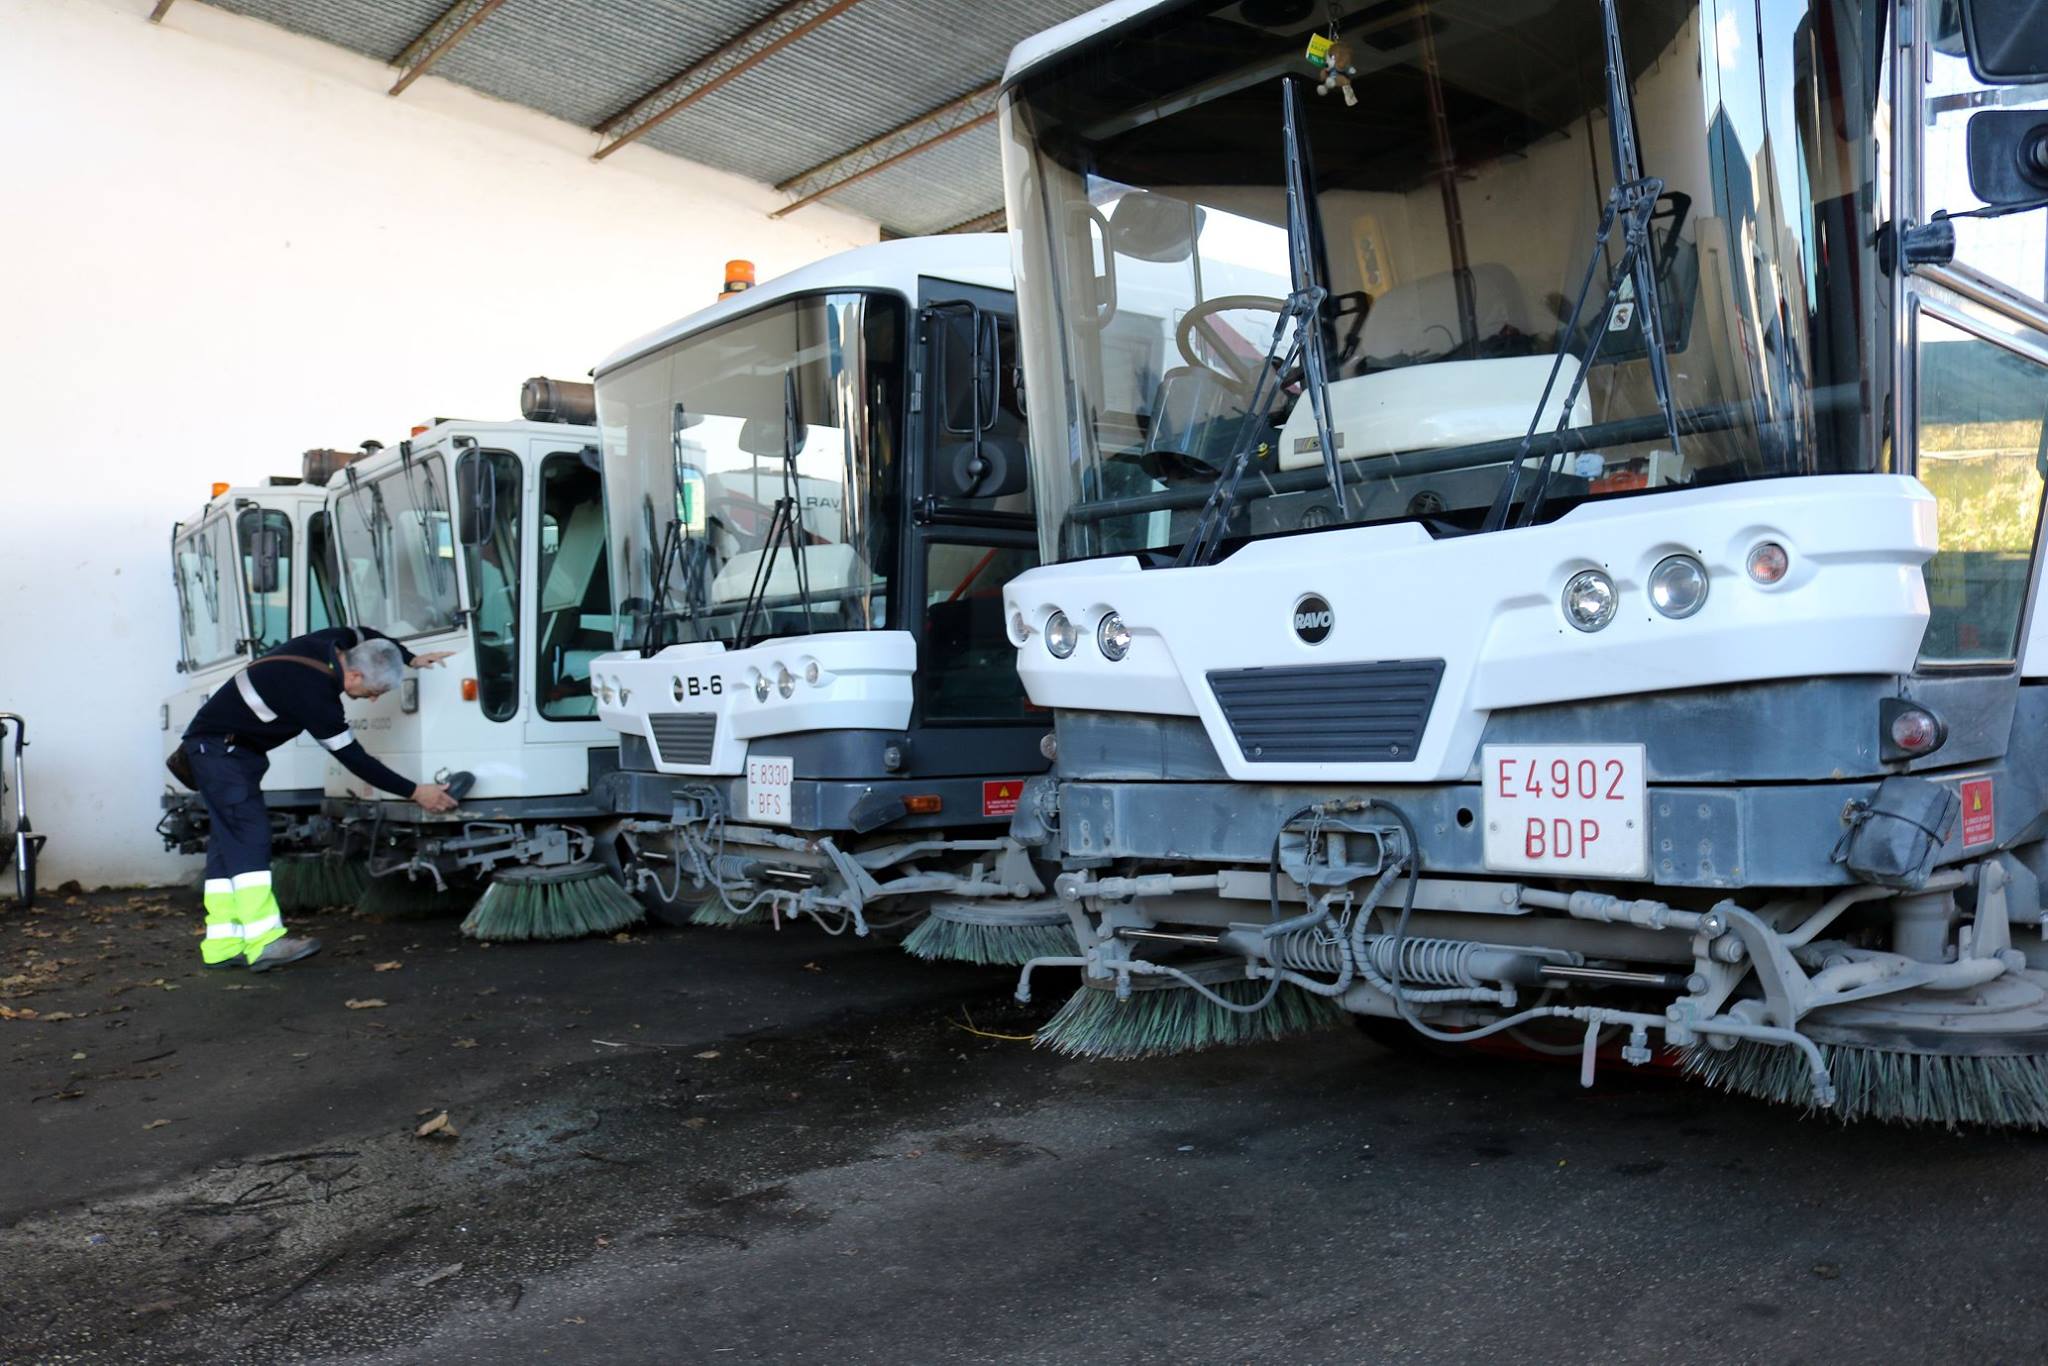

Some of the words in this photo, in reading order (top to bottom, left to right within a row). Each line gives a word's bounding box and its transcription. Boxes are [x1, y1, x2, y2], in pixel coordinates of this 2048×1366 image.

[1295, 611, 1331, 629] RAVO
[687, 675, 722, 696] B-6
[1499, 759, 1624, 800] E4902
[758, 793, 781, 815] BFS
[1525, 817, 1600, 858] BDP
